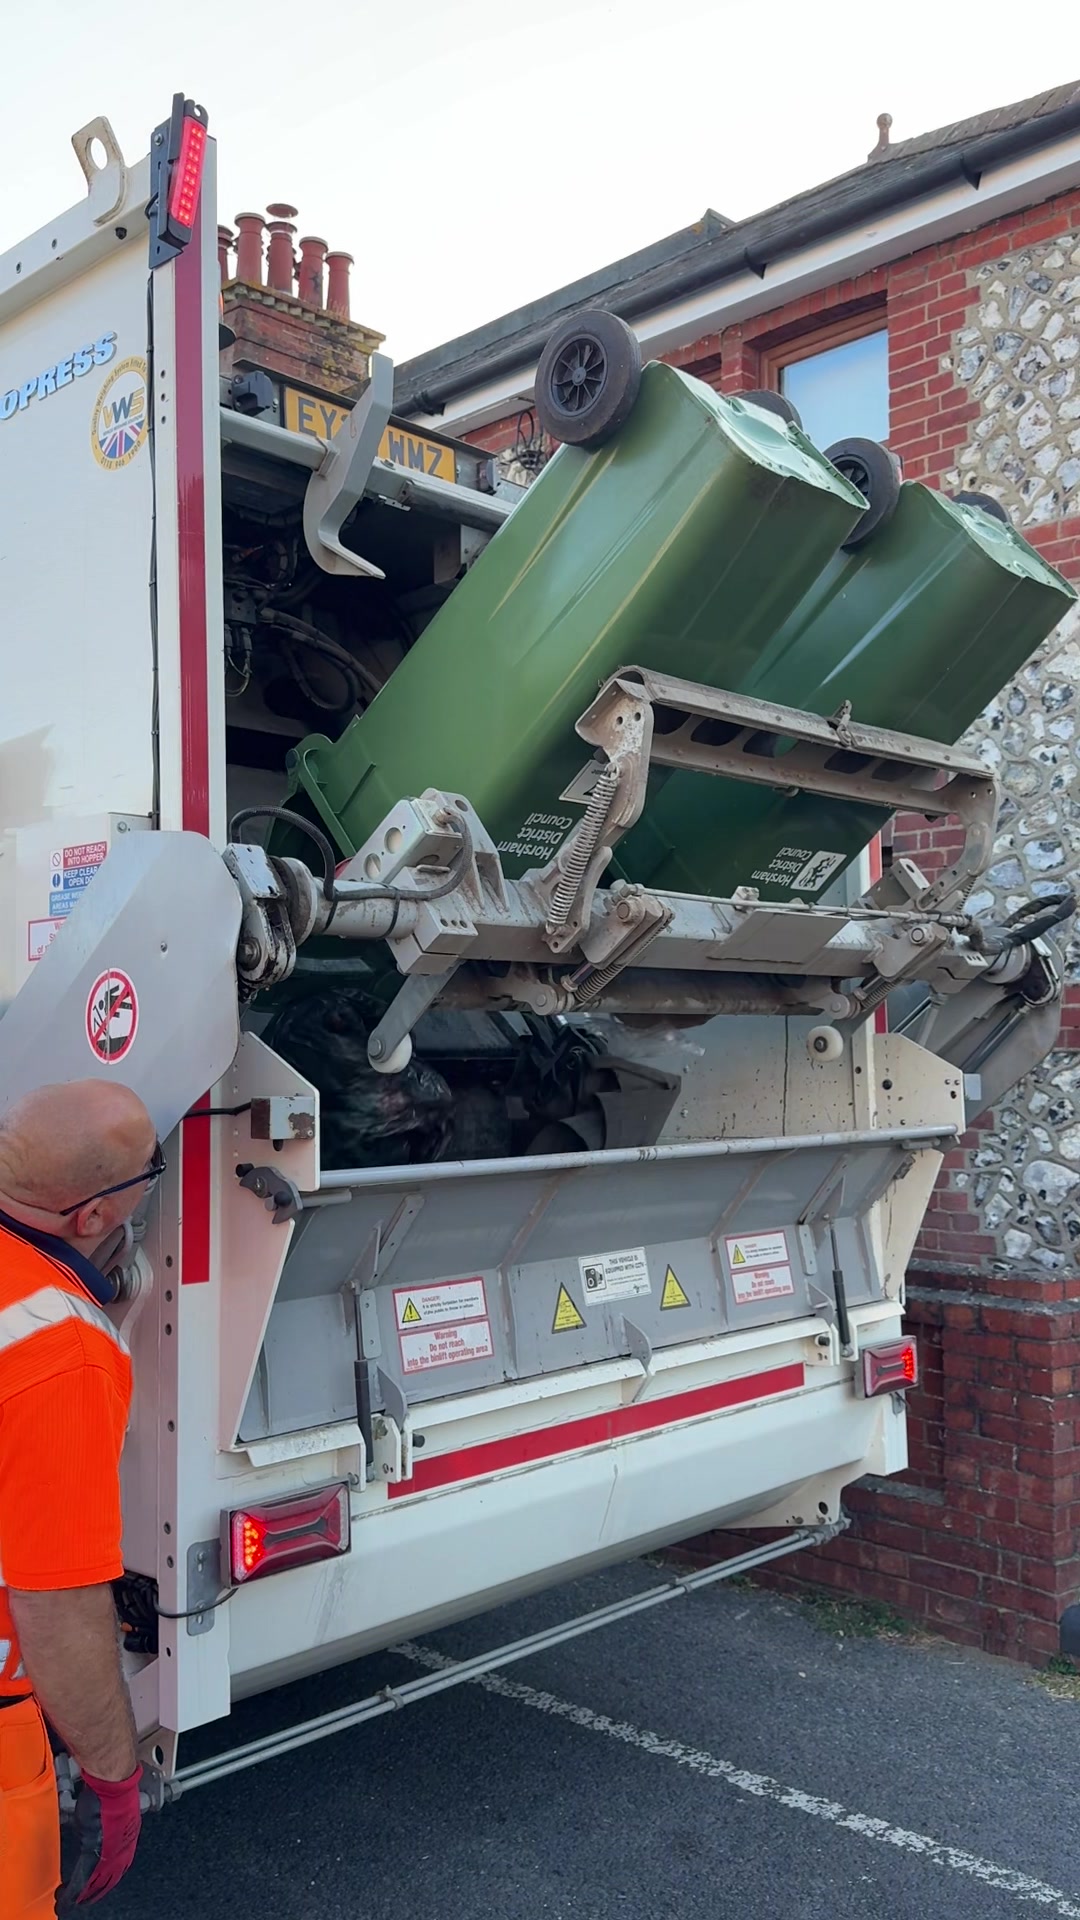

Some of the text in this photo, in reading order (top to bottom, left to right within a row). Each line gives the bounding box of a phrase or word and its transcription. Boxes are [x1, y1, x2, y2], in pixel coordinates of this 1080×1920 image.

[0, 331, 117, 420] OPRESS
[298, 396, 444, 479] EY WMZ
[524, 812, 573, 830] Council
[517, 827, 563, 844] District
[65, 843, 106, 858] DO NOT REACH
[497, 841, 554, 860] Horsham
[776, 847, 813, 861] Council
[67, 853, 104, 866] INTO HOPPER
[768, 859, 803, 873] District
[64, 866, 98, 879] KEEP CLEAR
[751, 870, 794, 886] Horsham
[68, 877, 84, 887] OPEN
[434, 1329, 458, 1340] Warning
[429, 1338, 465, 1352] Do not reach
[407, 1358, 419, 1367] into
[419, 1355, 429, 1365] the
[448, 1347, 475, 1360] operating
[476, 1345, 488, 1353] area
